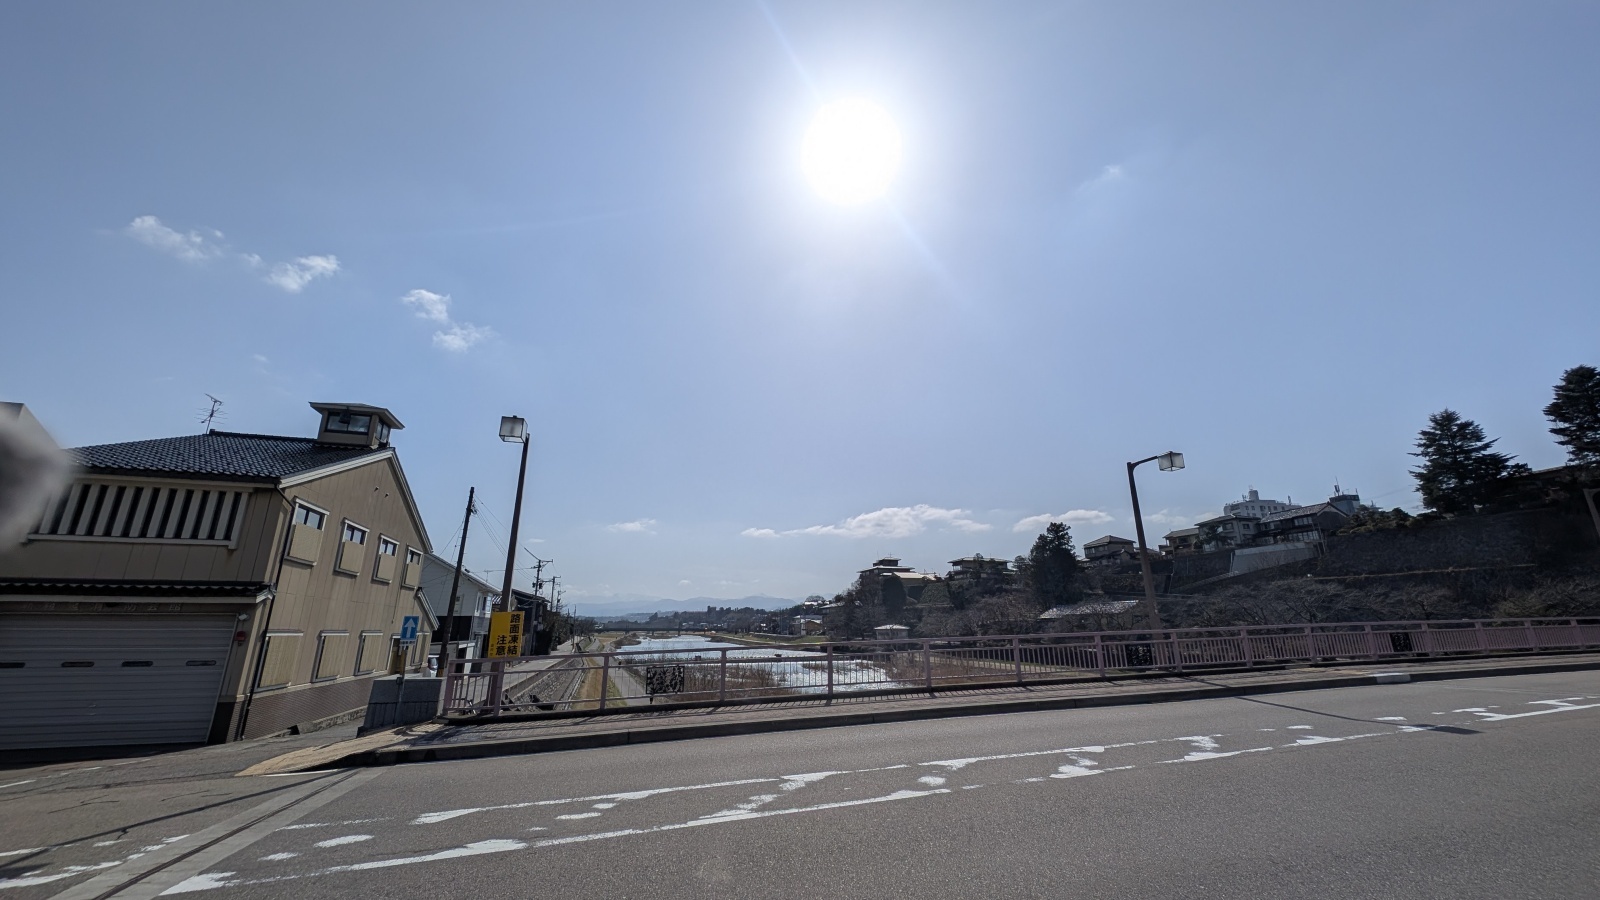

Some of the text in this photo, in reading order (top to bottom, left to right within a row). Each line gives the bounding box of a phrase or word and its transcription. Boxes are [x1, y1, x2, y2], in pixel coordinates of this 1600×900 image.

[495, 634, 507, 656] 注意
[507, 613, 521, 656] 路面凍結
